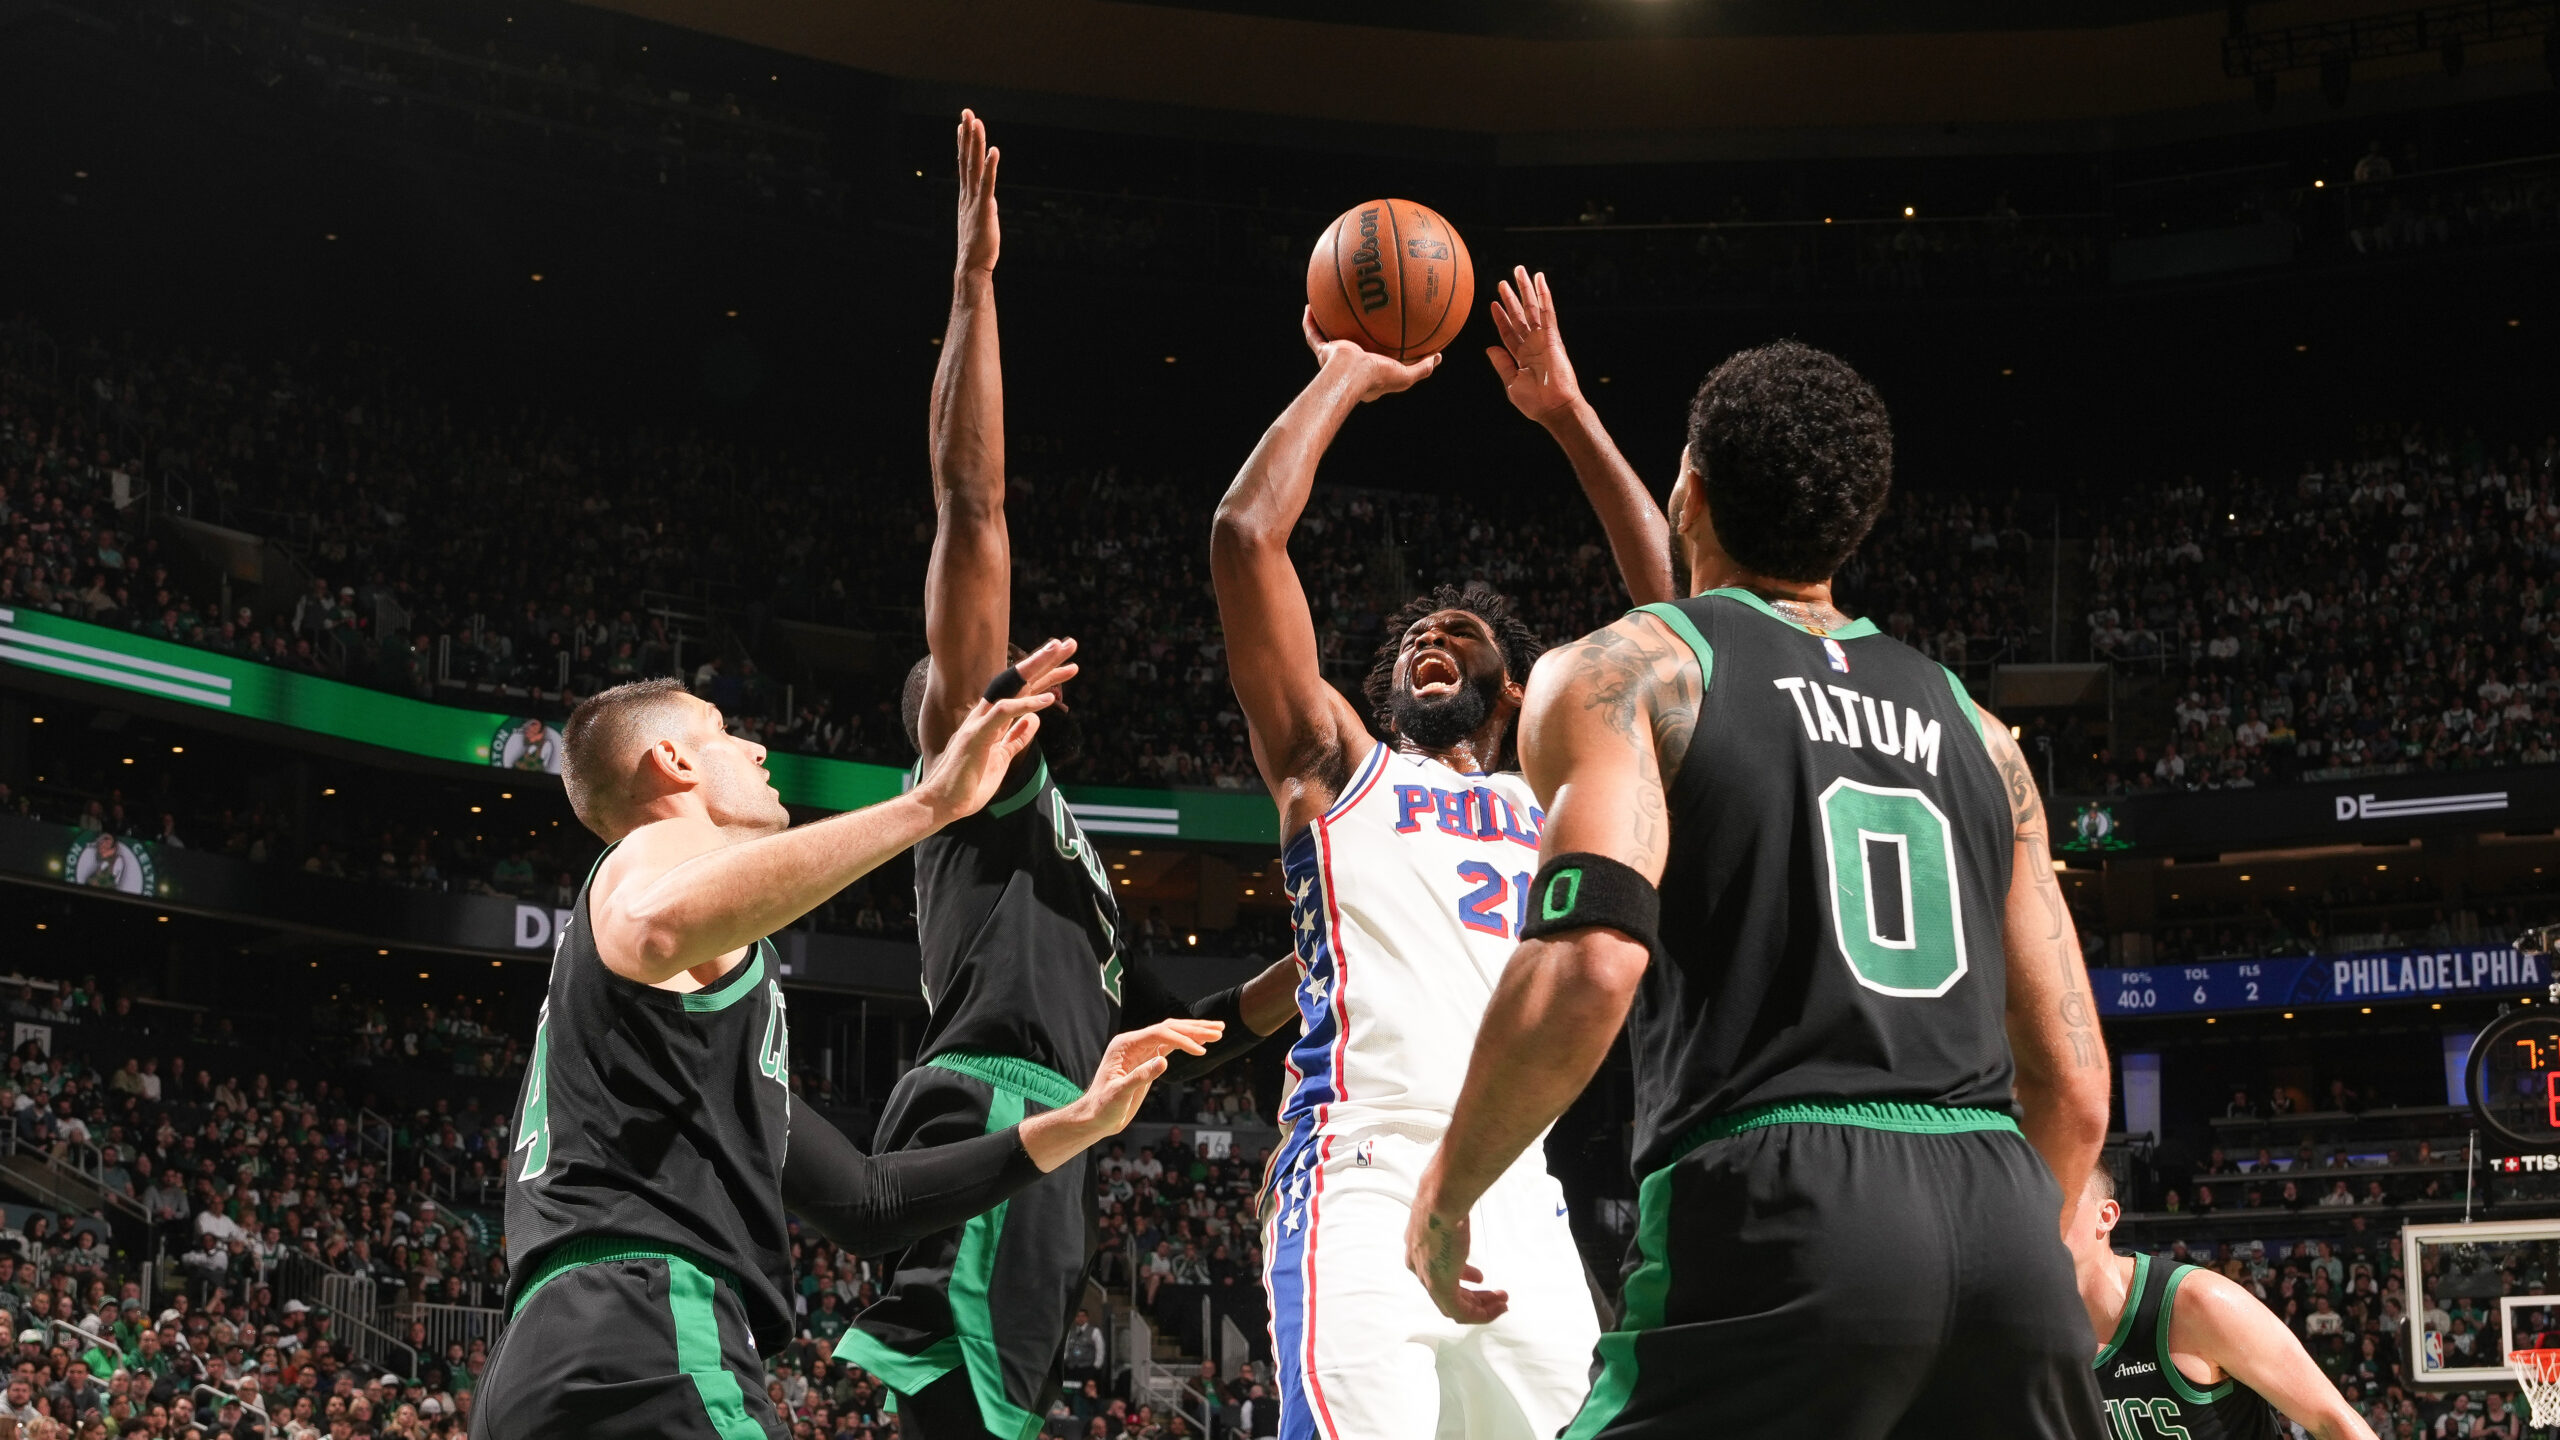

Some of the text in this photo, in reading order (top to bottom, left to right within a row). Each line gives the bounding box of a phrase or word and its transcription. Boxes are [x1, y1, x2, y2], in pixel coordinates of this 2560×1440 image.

[1352, 207, 1389, 316] Wilson
[1773, 676, 1941, 776] TATUM
[1457, 859, 1533, 942] 21
[1543, 868, 1583, 921] 0
[1818, 776, 1968, 998] 0
[2117, 981, 2259, 1009] 40.0 6 2
[2122, 964, 2261, 985] FG% TOL FLS
[2334, 950, 2539, 996] PHILADELPHIA
[2521, 1153, 2560, 1172] TIS
[2114, 1361, 2157, 1378] Amica
